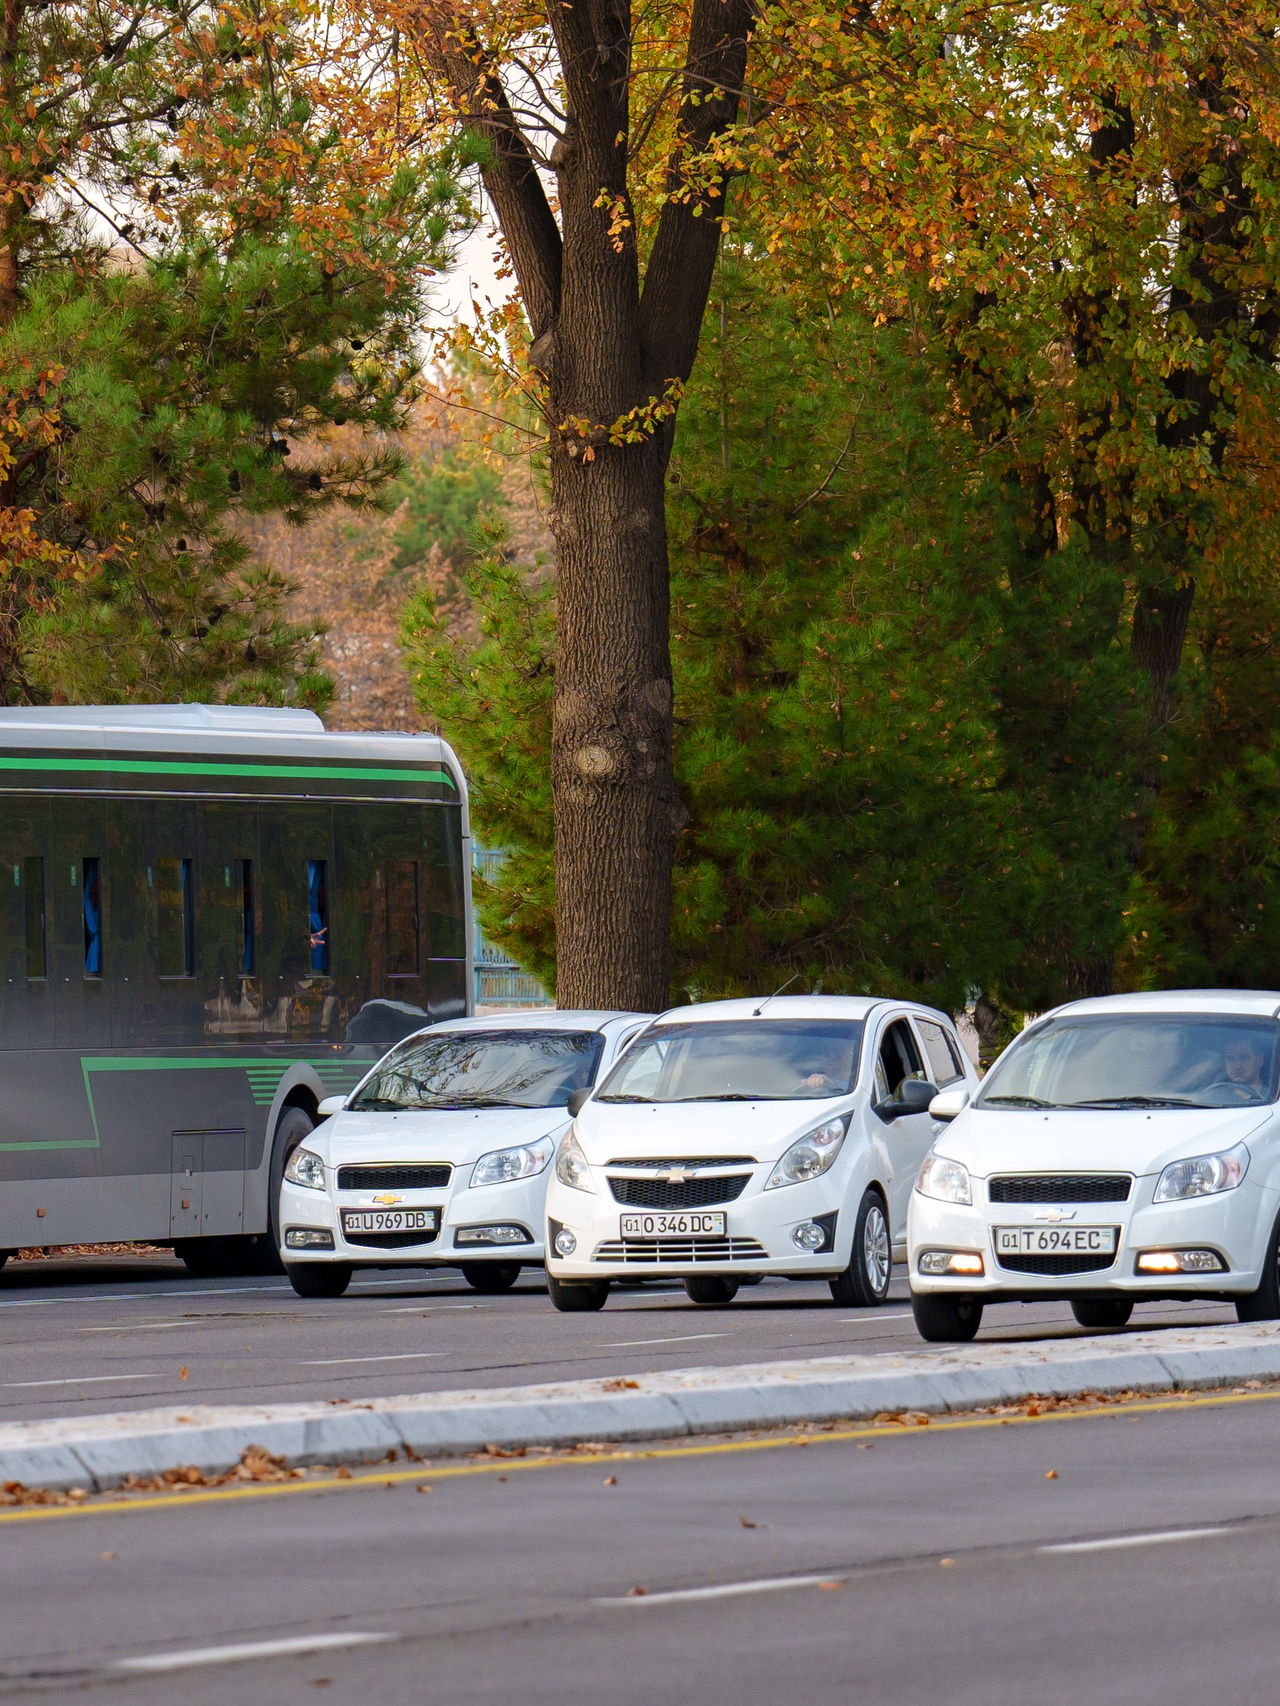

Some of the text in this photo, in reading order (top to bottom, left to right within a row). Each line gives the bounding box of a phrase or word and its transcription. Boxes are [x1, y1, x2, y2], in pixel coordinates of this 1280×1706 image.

[347, 1212, 426, 1229] 01 U 969 DB
[625, 1219, 640, 1231] 01
[657, 1216, 687, 1233] 346
[690, 1215, 713, 1232] DC
[1001, 1231, 1101, 1250] 01 T 694 EC
